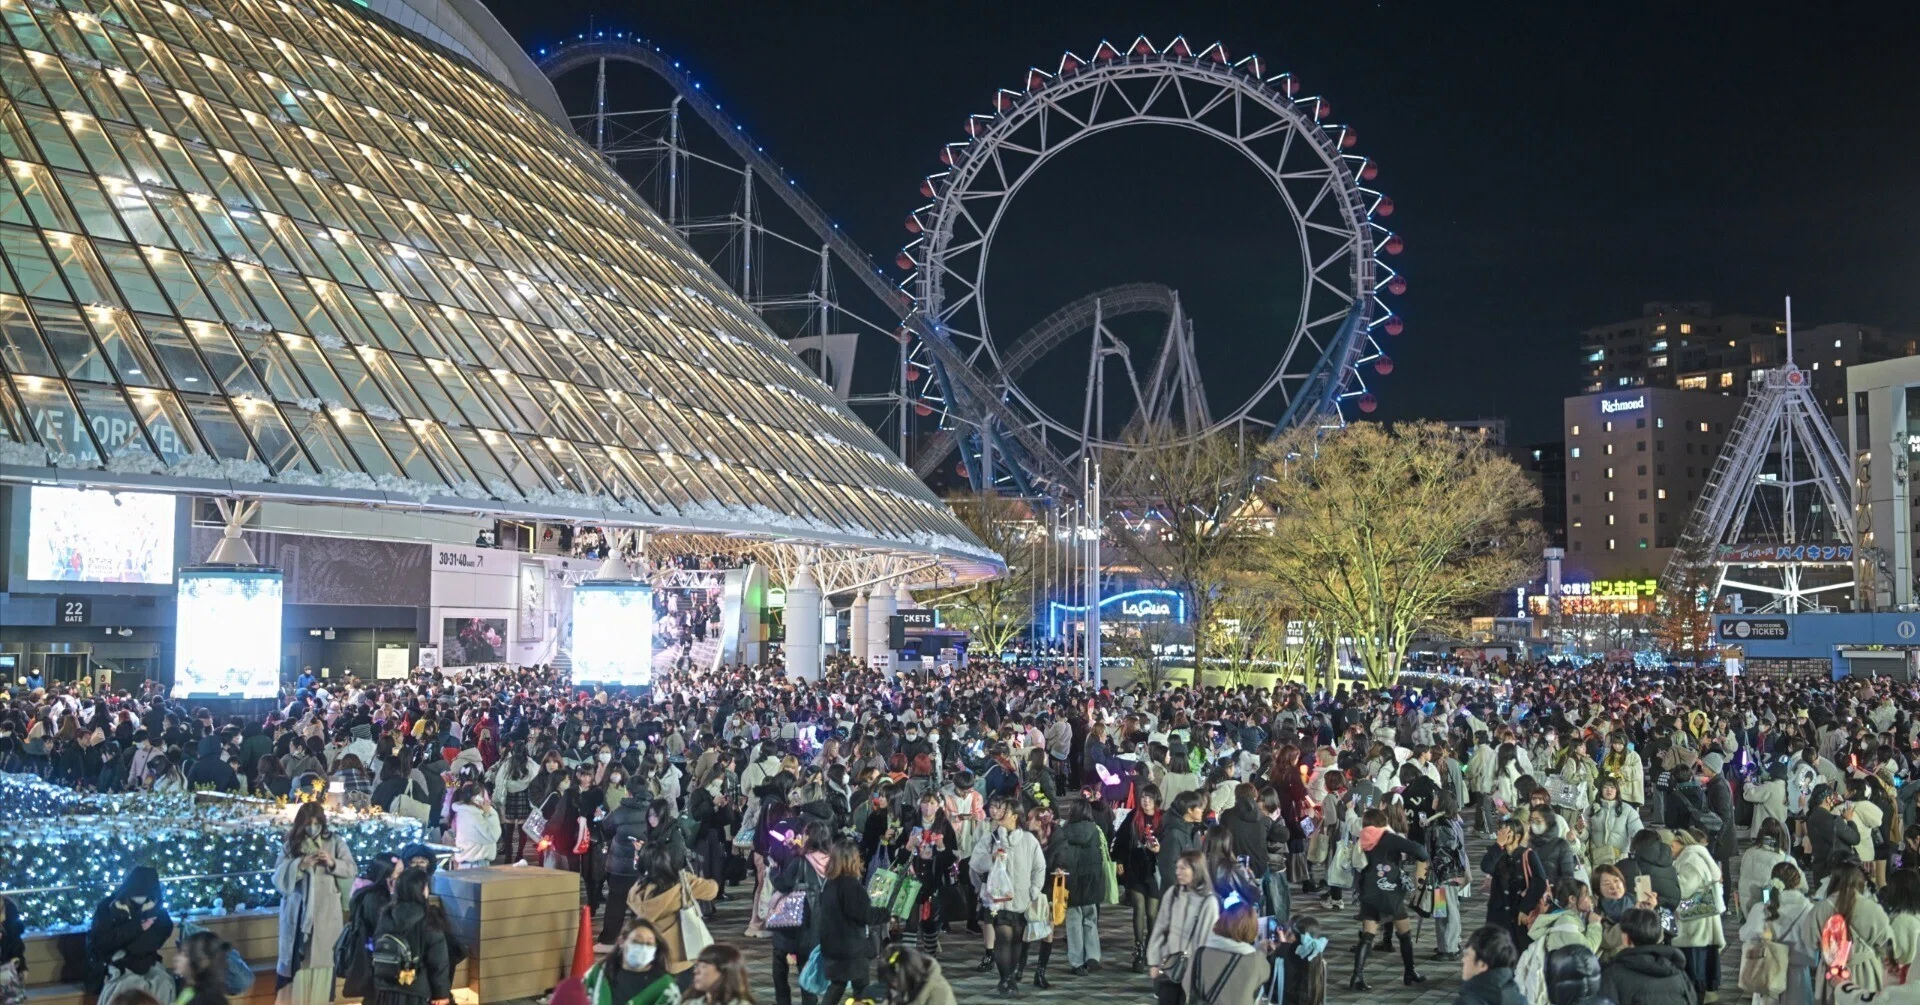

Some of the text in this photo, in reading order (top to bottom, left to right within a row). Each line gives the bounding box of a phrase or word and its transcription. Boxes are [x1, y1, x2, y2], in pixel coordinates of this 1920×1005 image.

[1601, 396, 1645, 413] Richmond
[1776, 545, 1852, 560] バイキング
[65, 602, 83, 615] 22
[65, 615, 83, 623] GATE
[903, 614, 931, 623] CKETS
[1751, 628, 1784, 636] TICKETS
